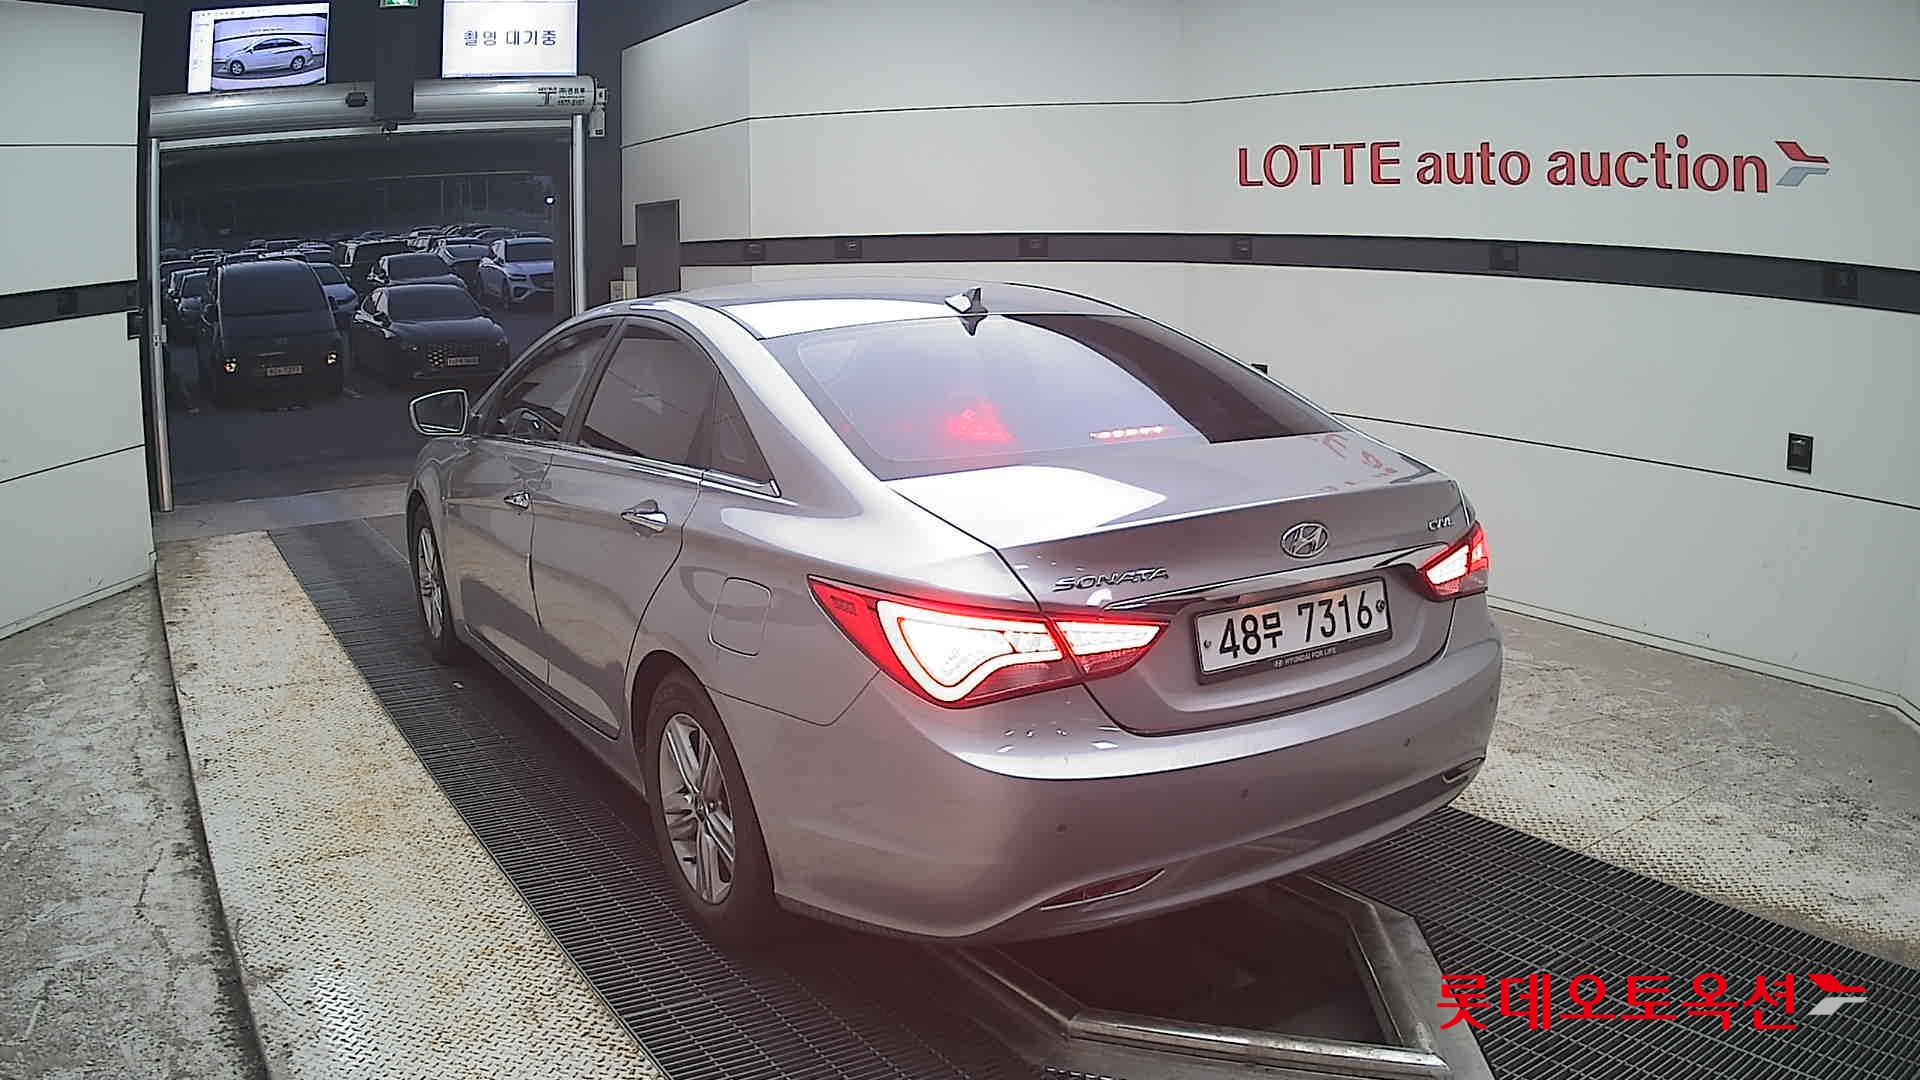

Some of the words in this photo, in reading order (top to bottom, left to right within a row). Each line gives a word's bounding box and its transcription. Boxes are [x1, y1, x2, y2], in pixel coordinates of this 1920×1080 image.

[505, 28, 557, 47] 대기중
[1238, 140, 1401, 188] LOTTE
[1416, 141, 1532, 186] auto
[1546, 134, 1769, 194] auction
[1053, 567, 1169, 592] SONATA
[1218, 611, 1283, 658] 48무
[1297, 590, 1373, 643] 7316
